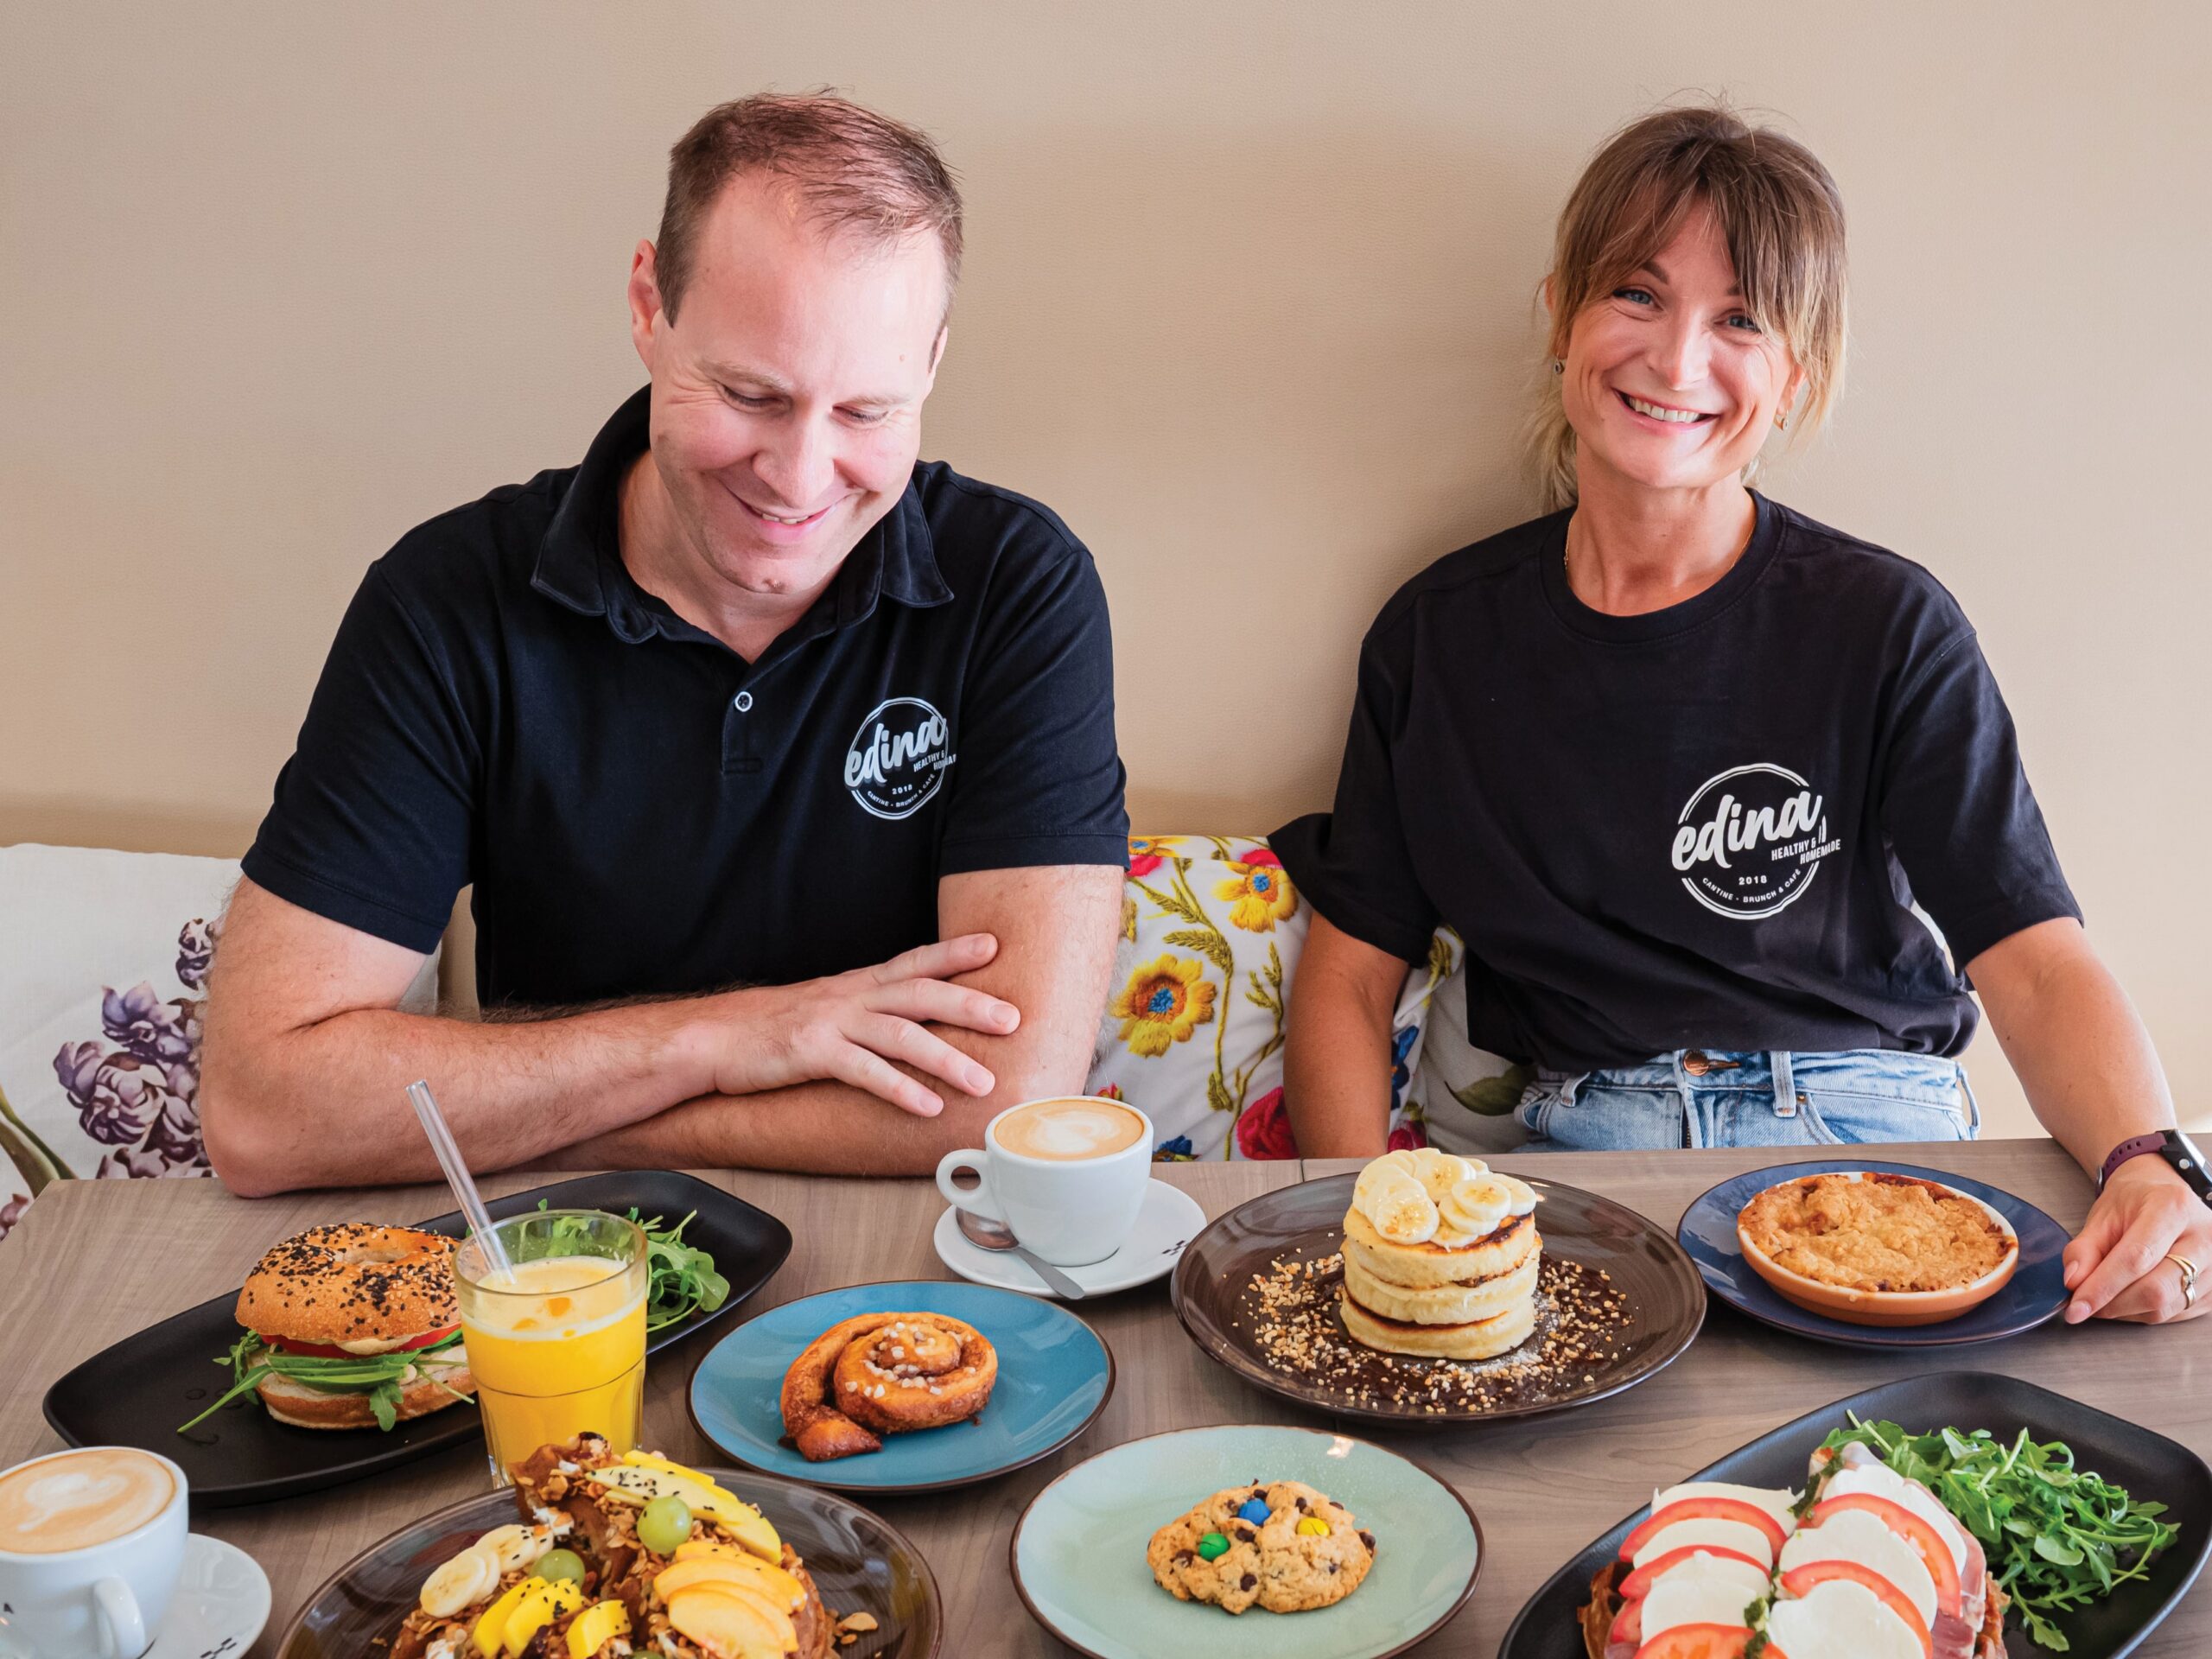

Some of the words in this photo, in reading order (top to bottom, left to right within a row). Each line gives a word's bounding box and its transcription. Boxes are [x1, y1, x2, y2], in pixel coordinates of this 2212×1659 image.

[844, 715, 946, 788] edina
[913, 753, 940, 772] HEALTHY
[868, 791, 889, 806] CANTINE
[896, 793, 918, 807] BRUNCH
[892, 784, 913, 795] 2018
[1671, 791, 1823, 871] edina
[1771, 840, 1809, 861] HEALTHY
[1810, 836, 1816, 849] &
[1800, 839, 1840, 864] HOMEMADE
[1703, 877, 1733, 900] CANTINE
[1743, 891, 1777, 903] BRUNCH
[1738, 875, 1767, 886] 2018
